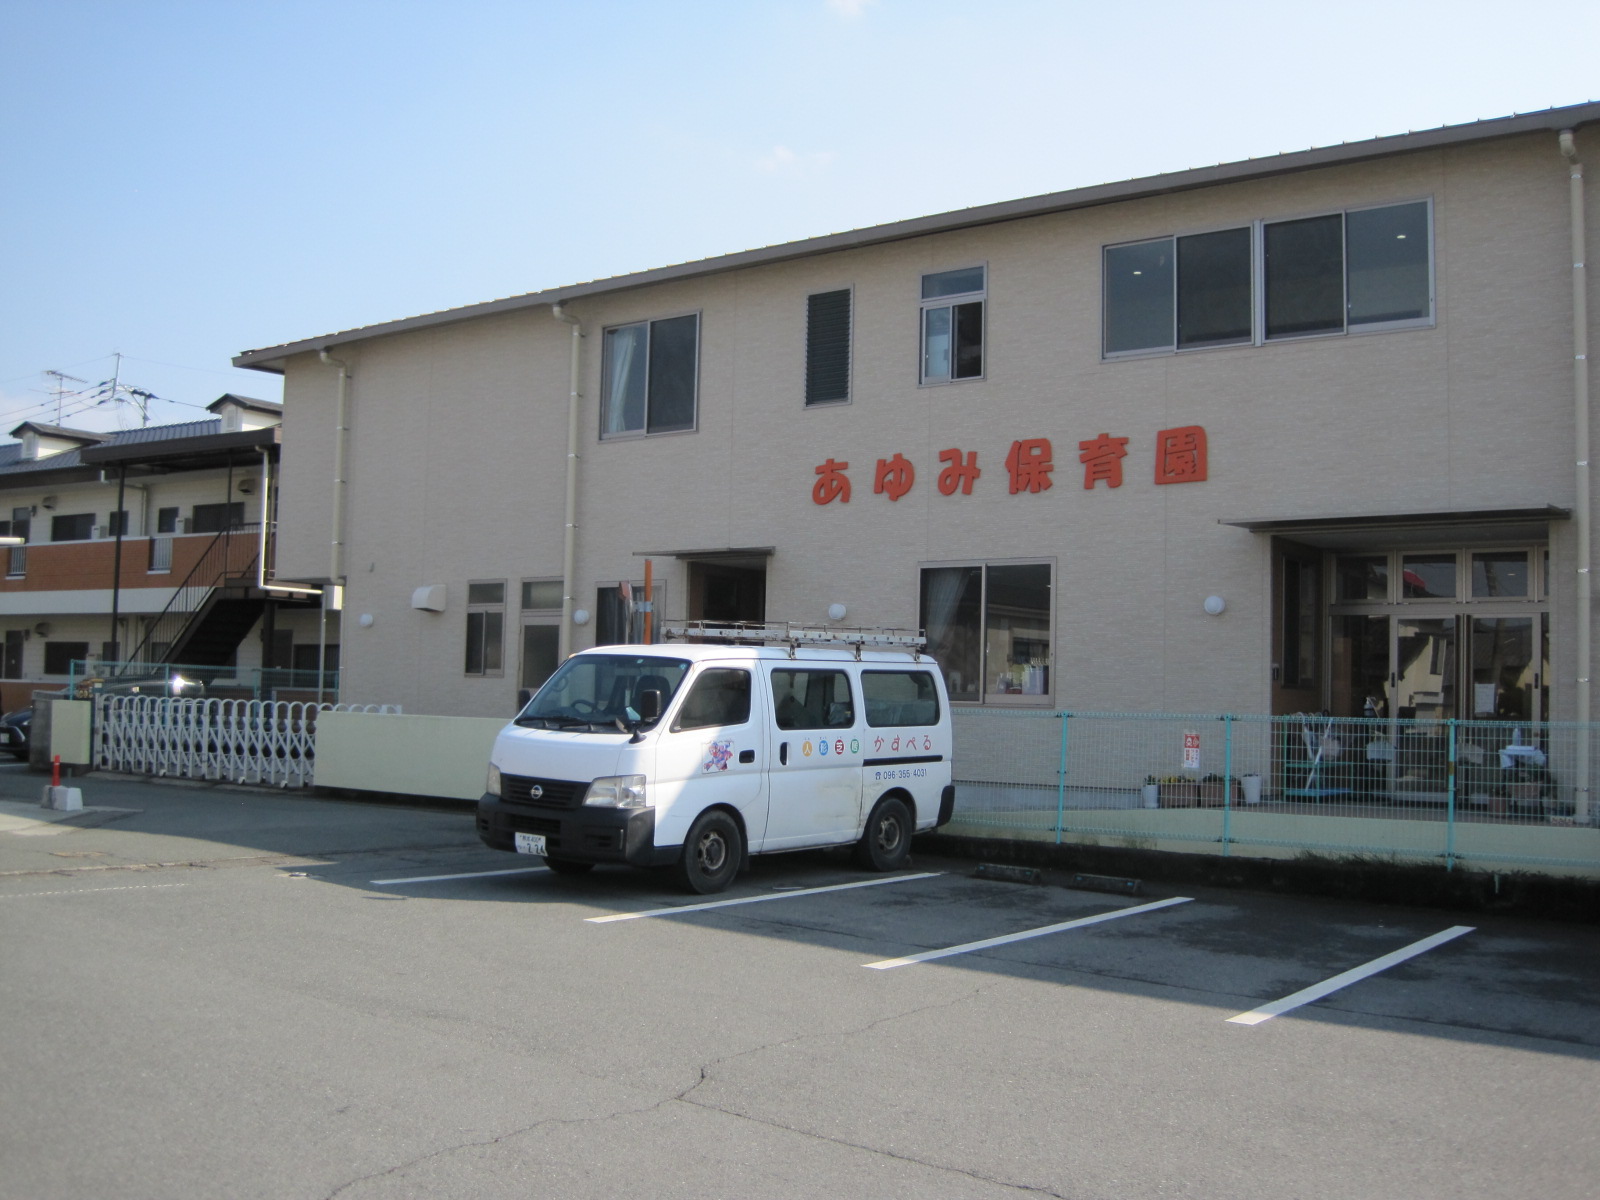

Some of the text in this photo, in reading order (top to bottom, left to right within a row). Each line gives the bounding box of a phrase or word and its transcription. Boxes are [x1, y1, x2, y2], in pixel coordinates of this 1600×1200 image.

[812, 425, 1208, 505] あゆみ保育園
[803, 739, 860, 756] 人形芝居
